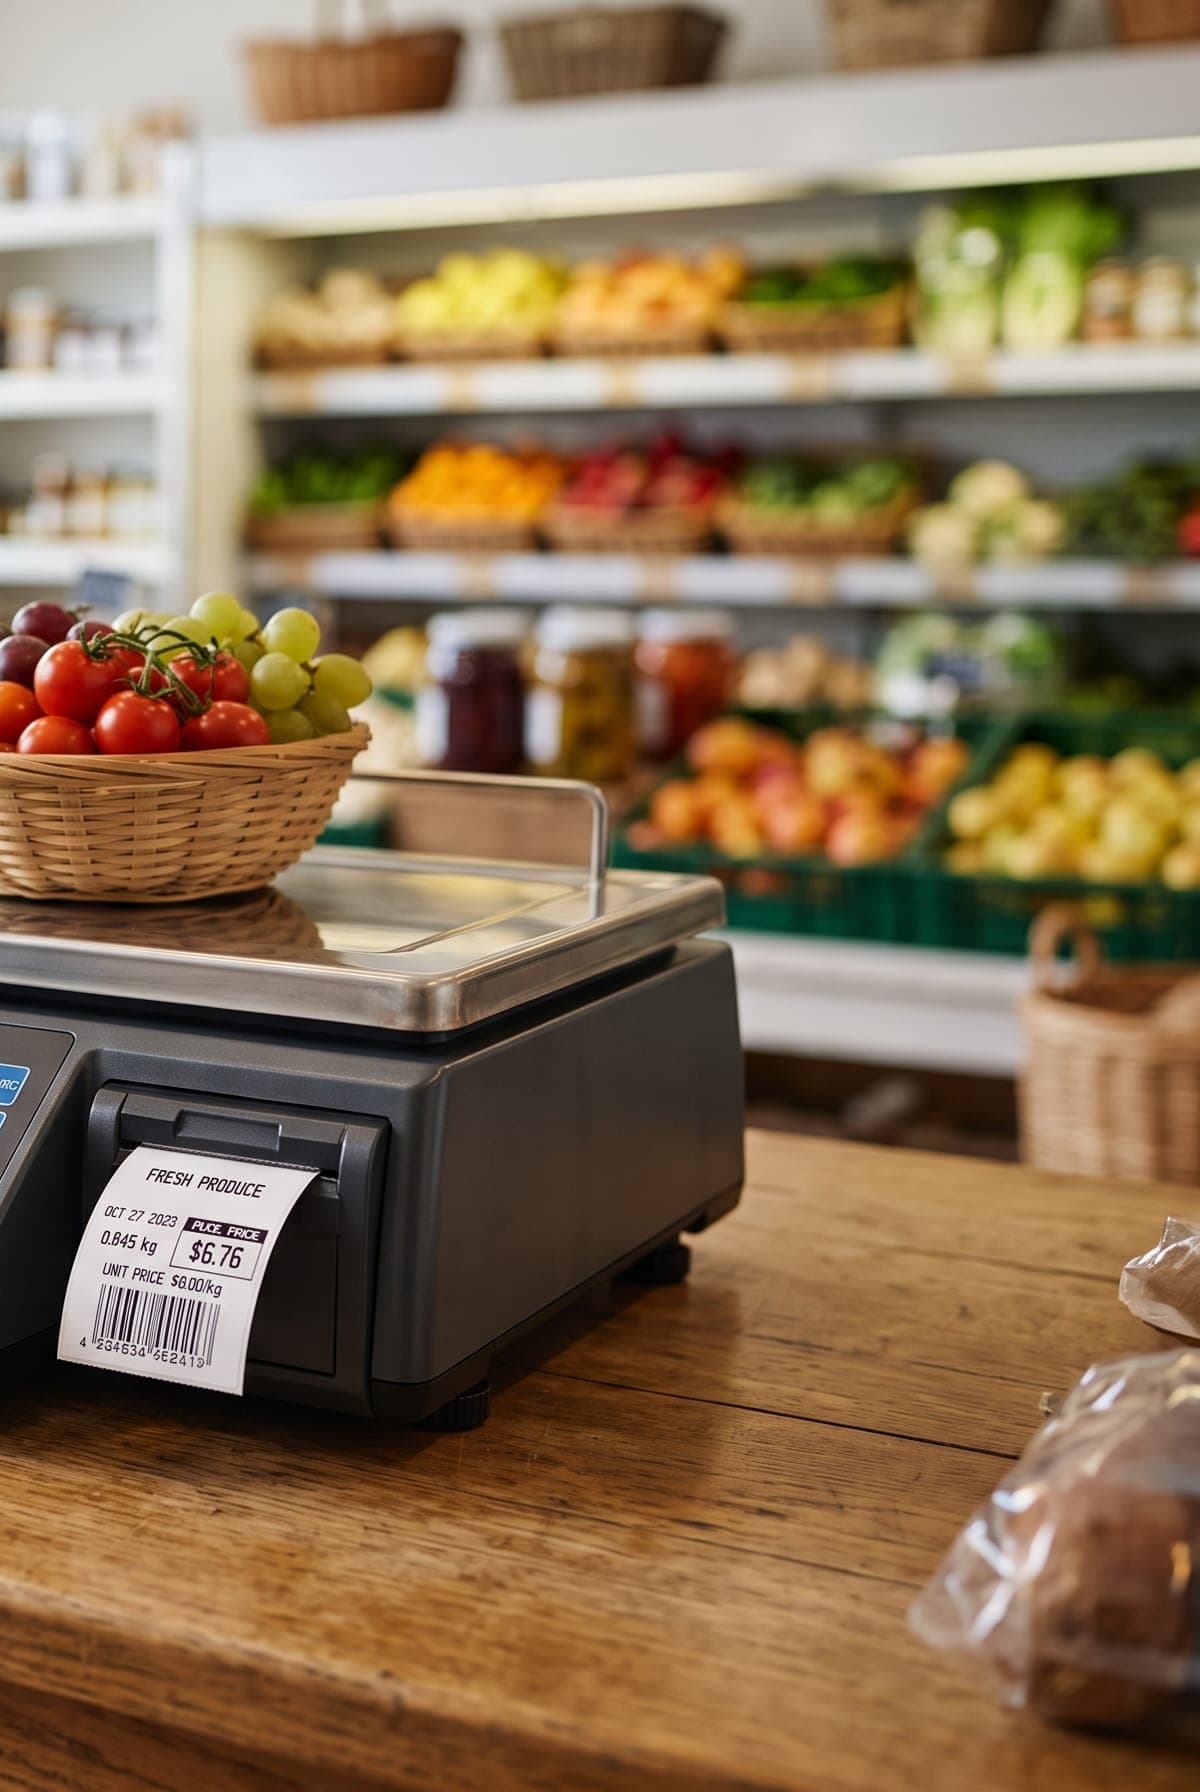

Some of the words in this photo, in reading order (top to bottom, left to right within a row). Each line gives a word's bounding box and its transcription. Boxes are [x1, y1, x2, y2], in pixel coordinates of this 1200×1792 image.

[146, 1168, 194, 1187] FRESH
[197, 1176, 266, 1198] PRODUCE
[104, 1206, 126, 1219] OCT
[128, 1209, 145, 1222] 27
[147, 1213, 178, 1228] 2023
[140, 1236, 158, 1256] kg
[188, 1239, 244, 1269] $6.76
[102, 1262, 130, 1278] UNIT
[132, 1267, 166, 1286] PRICE
[80, 1336, 87, 1348] 4
